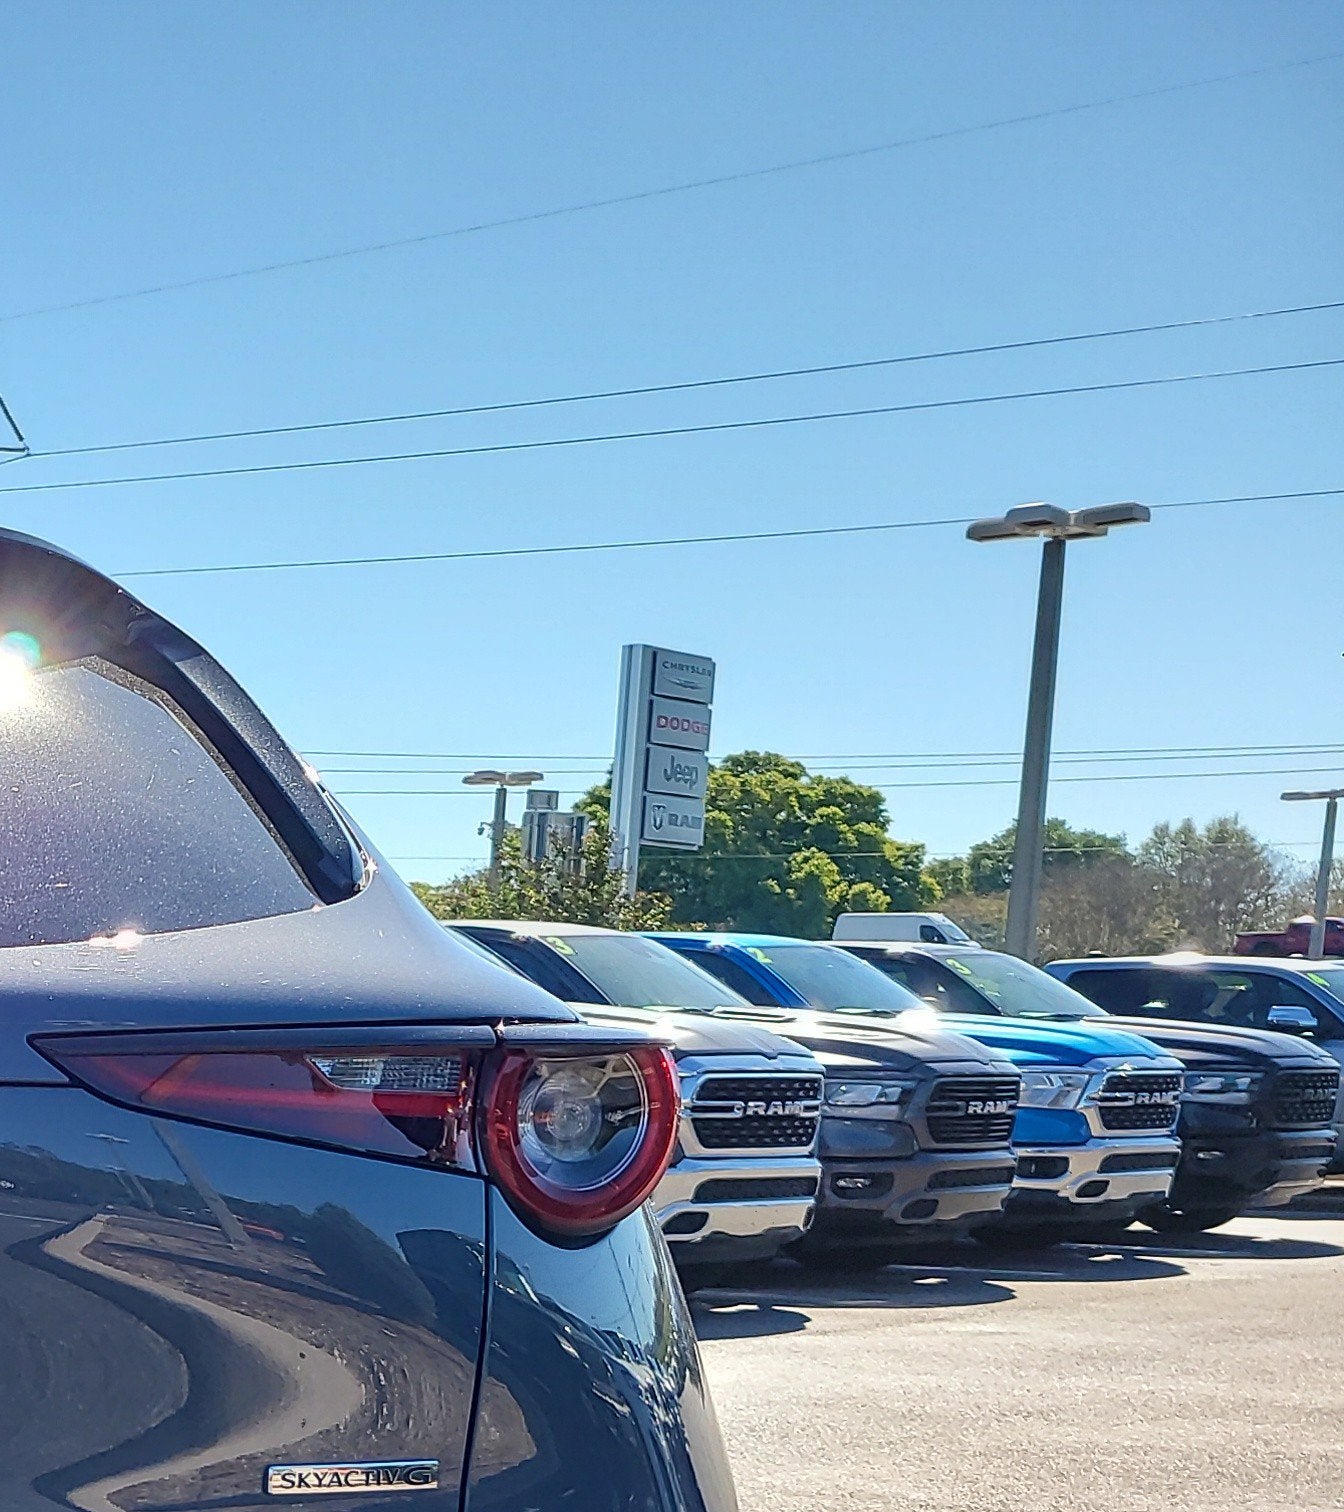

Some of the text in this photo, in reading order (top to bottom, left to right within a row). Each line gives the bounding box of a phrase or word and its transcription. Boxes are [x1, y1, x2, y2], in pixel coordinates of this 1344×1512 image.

[656, 714, 709, 735] DODGE
[664, 754, 699, 790] Jeep
[746, 1101, 802, 1115] RAM
[967, 1100, 1009, 1115] RAM
